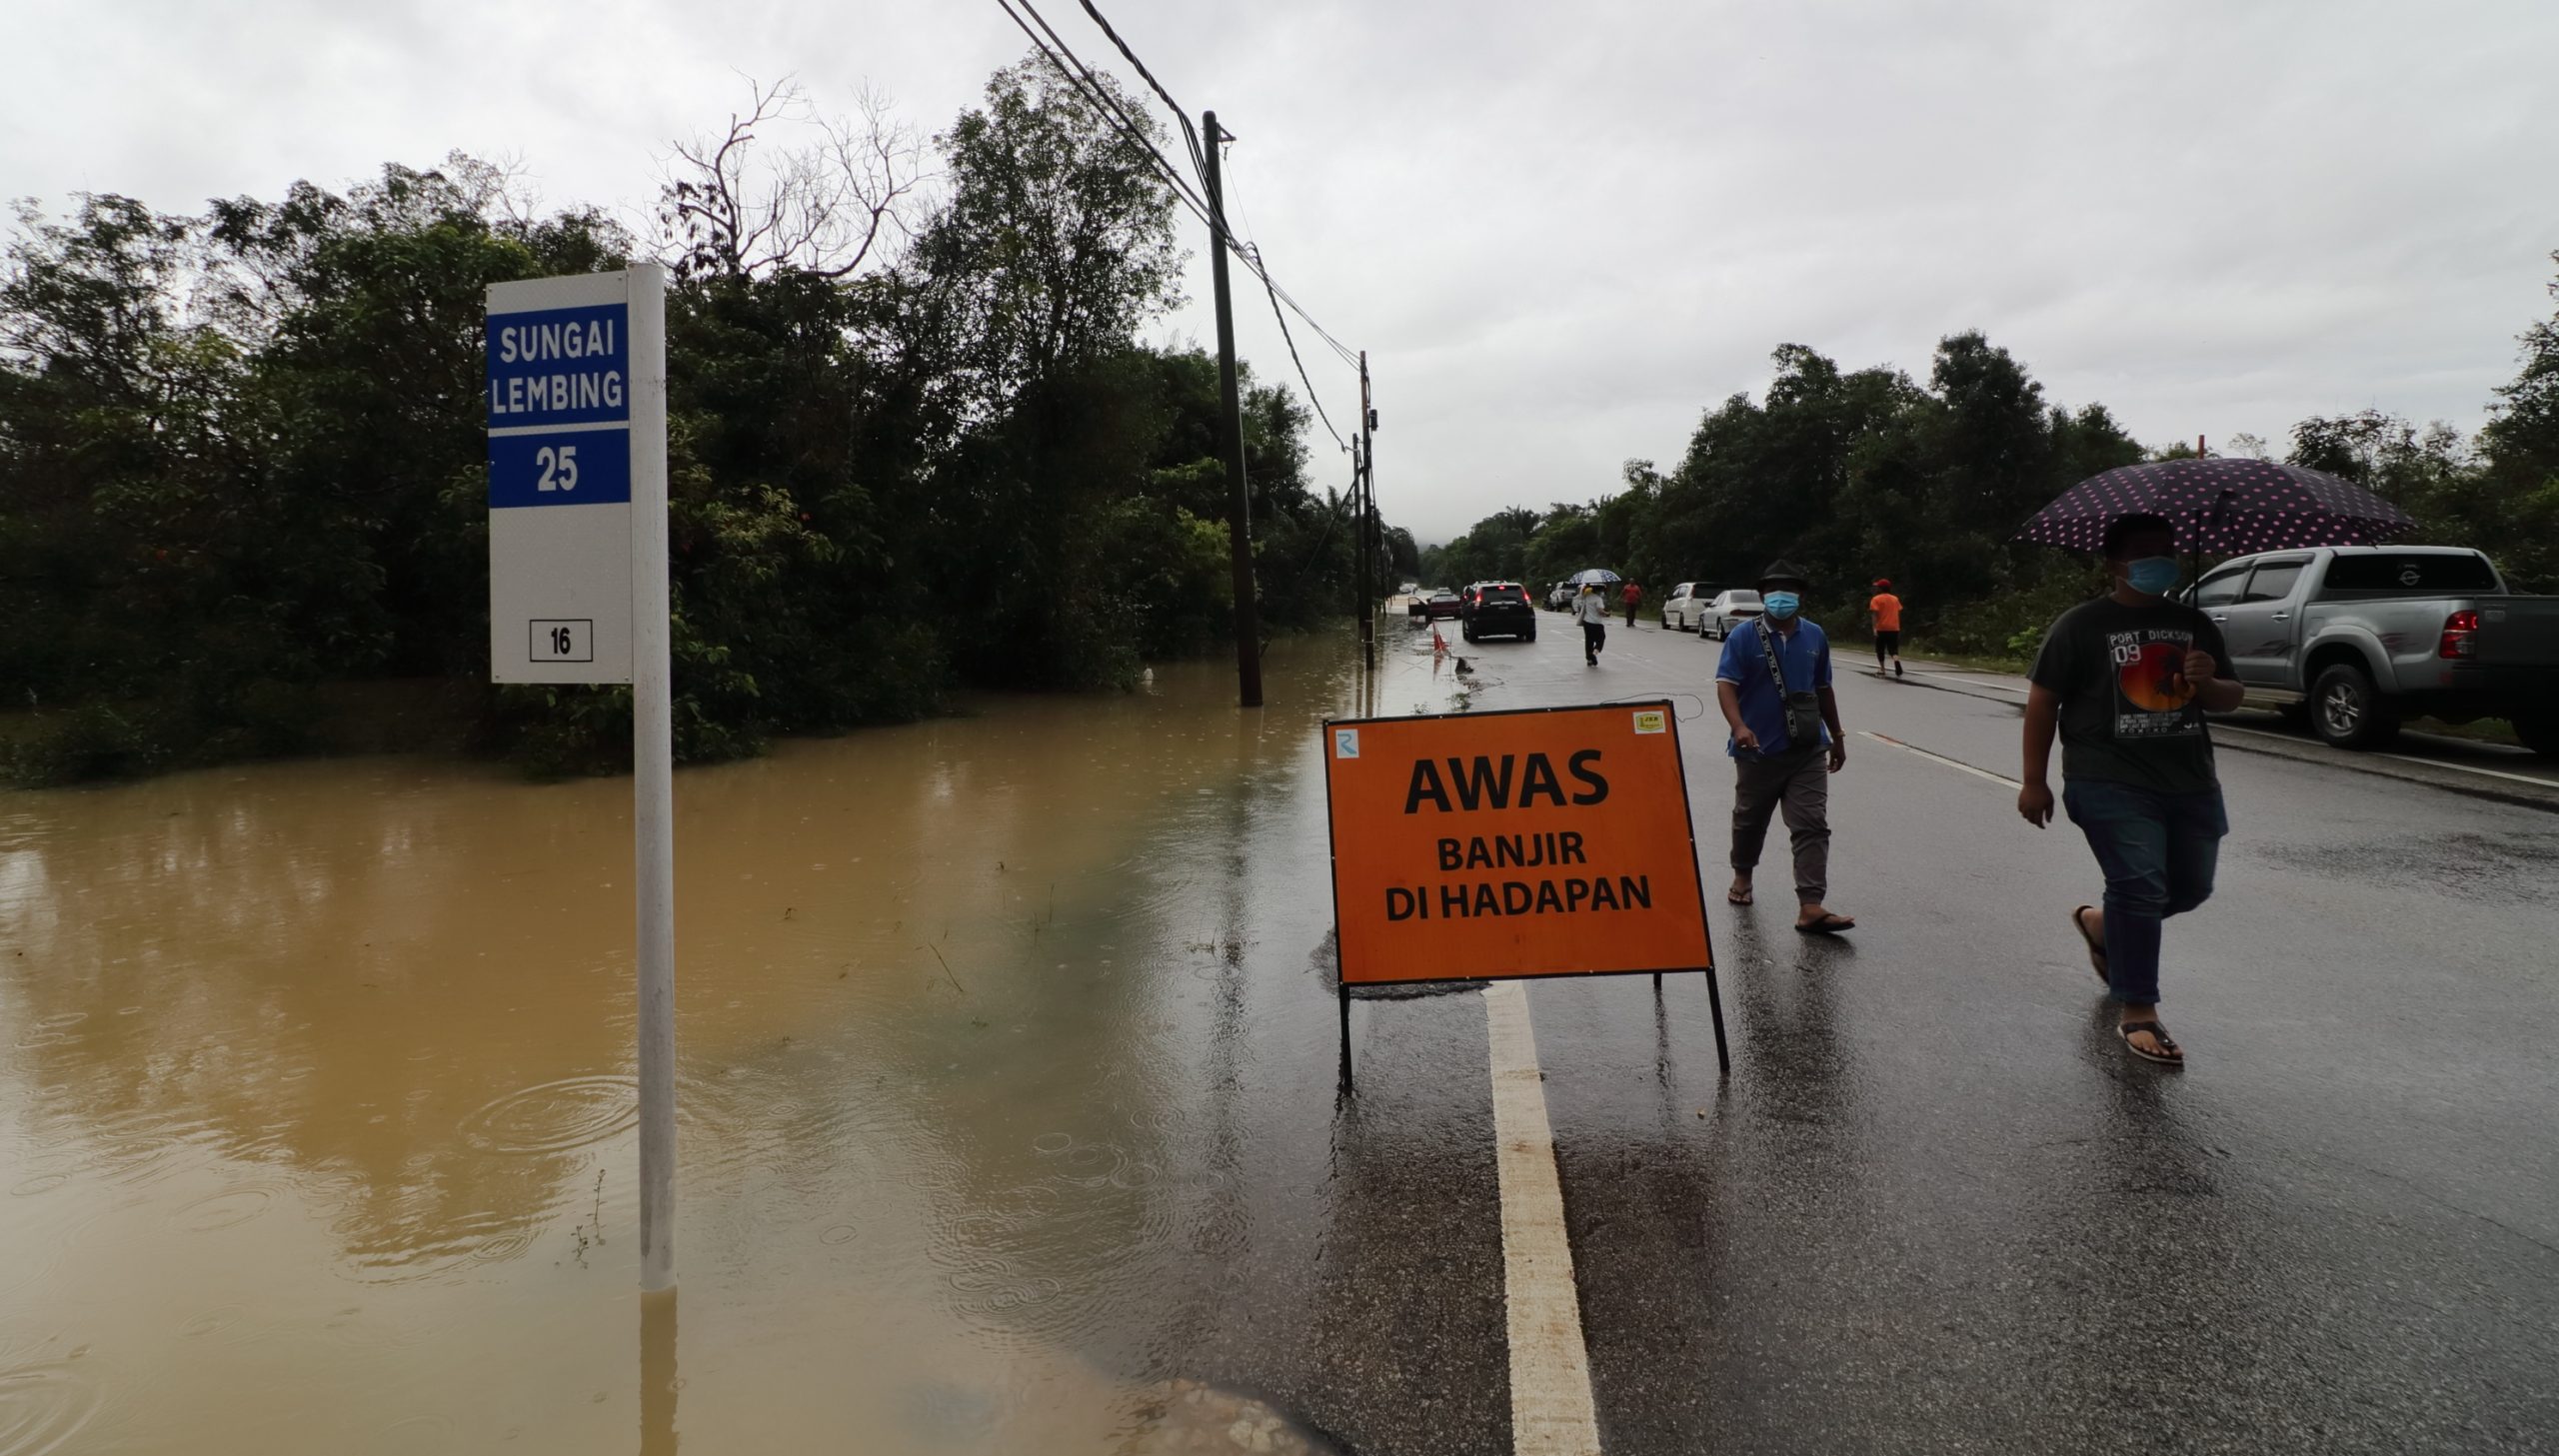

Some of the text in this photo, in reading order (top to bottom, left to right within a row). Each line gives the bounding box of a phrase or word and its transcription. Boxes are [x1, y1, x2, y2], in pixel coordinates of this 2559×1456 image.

[500, 319, 614, 363] SUNGAI
[492, 370, 623, 414] LEMBING
[536, 446, 578, 492] 25
[551, 627, 571, 655] 16
[2109, 630, 2193, 647] PORT DICKSON
[1403, 749, 1609, 814] AWAS
[1436, 831, 1586, 871] BANJIR
[1385, 875, 1652, 921] DI HADAPAN
